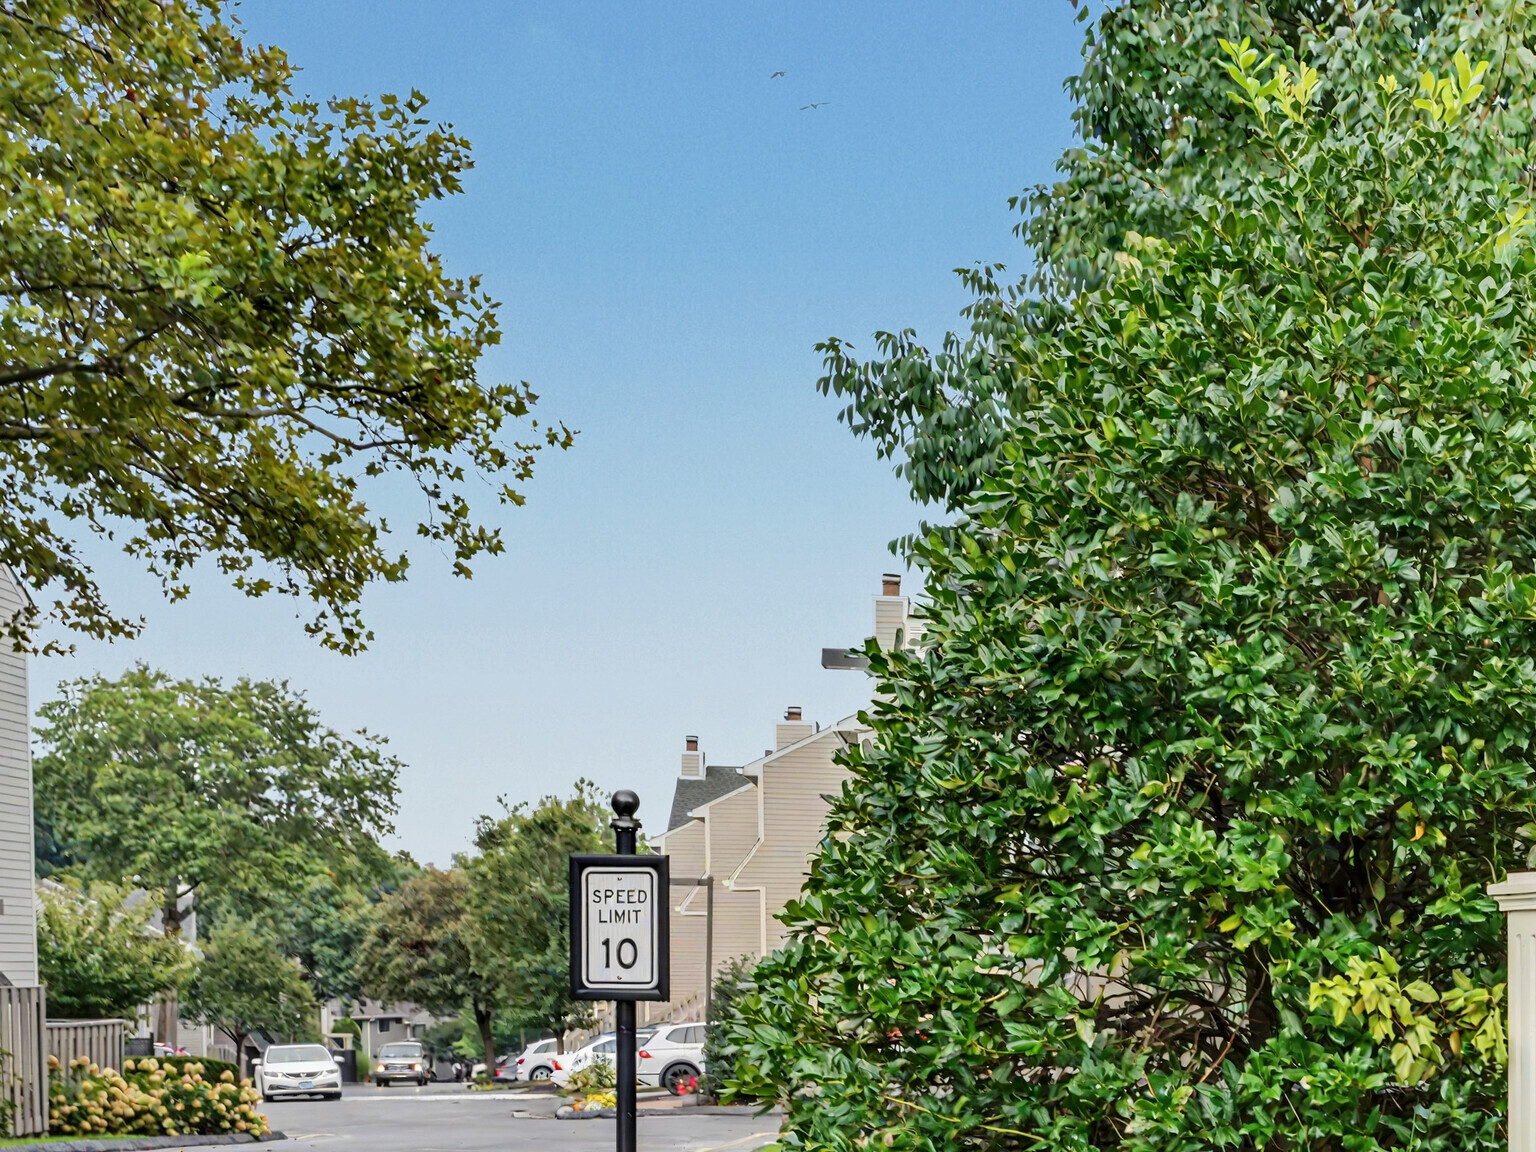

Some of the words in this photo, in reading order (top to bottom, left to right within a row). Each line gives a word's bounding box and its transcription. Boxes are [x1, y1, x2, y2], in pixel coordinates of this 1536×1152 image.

[592, 889, 648, 905] SPEED
[598, 909, 642, 925] LIMIT
[601, 937, 638, 970] 10
